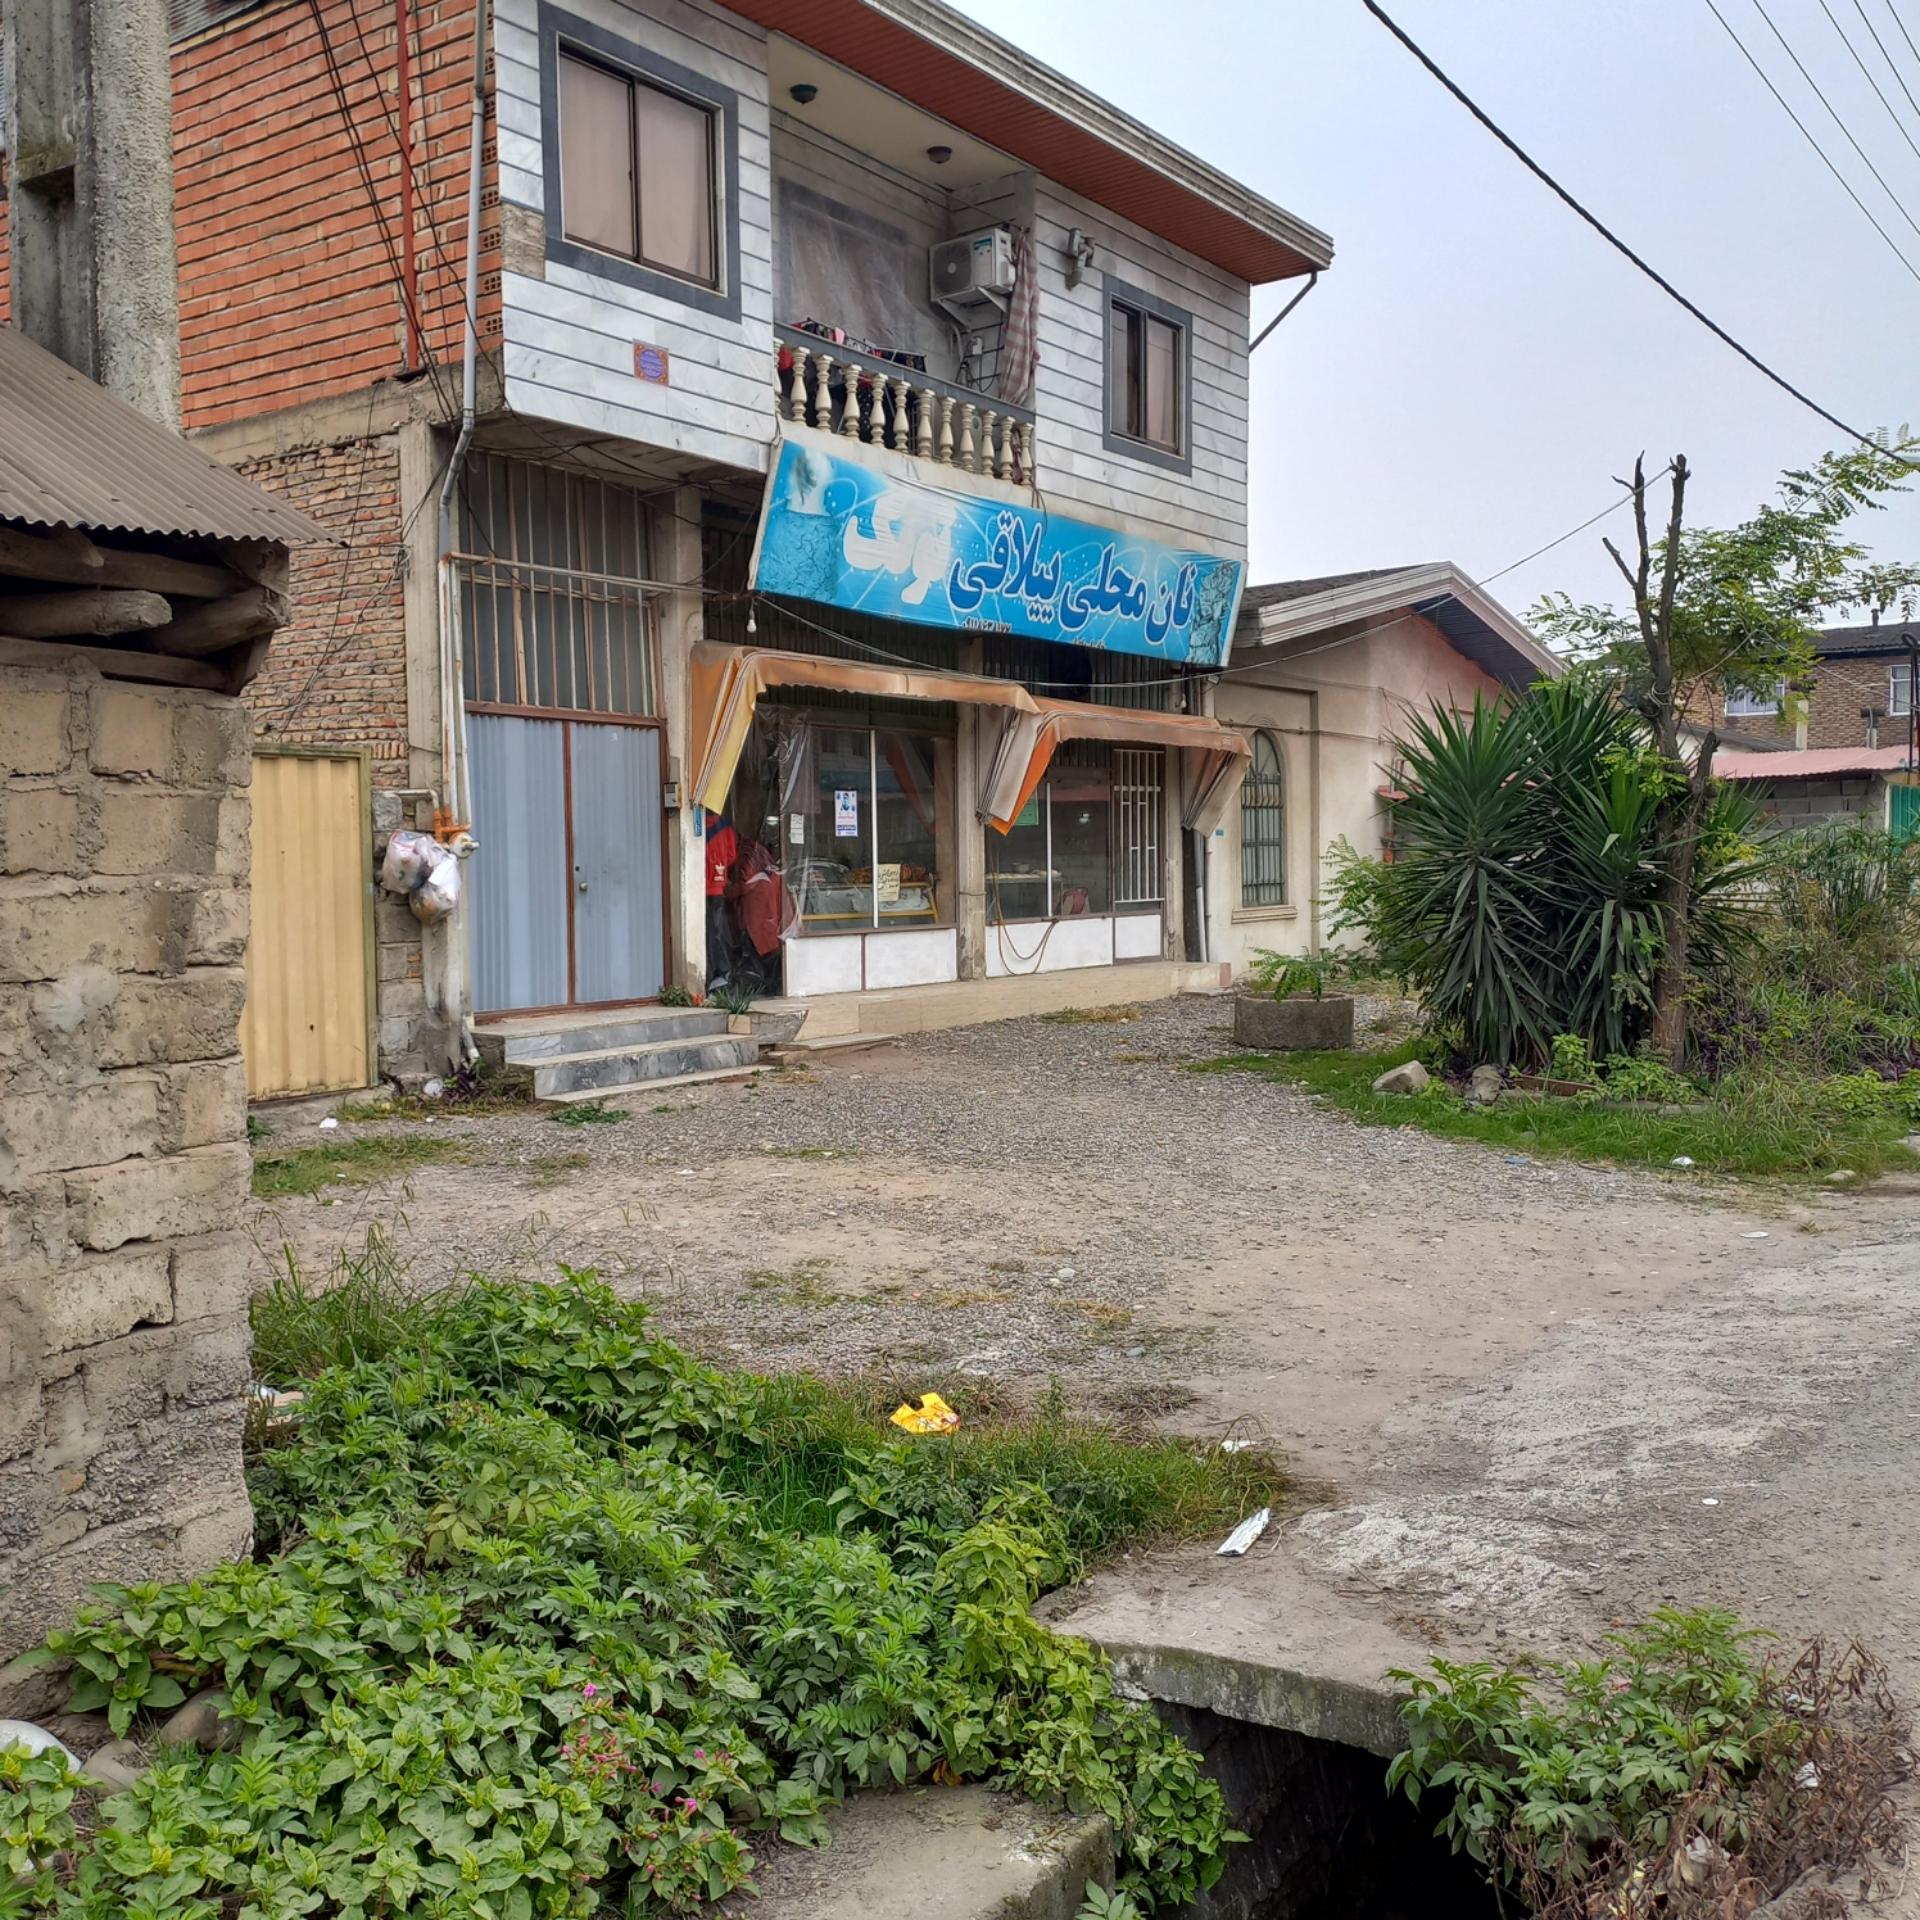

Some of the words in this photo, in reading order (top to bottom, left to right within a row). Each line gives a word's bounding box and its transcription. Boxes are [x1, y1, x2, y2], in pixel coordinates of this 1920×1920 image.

[948, 510, 1061, 624] ییلاقی
[1058, 542, 1147, 632] محلی
[1145, 561, 1198, 645] نان
